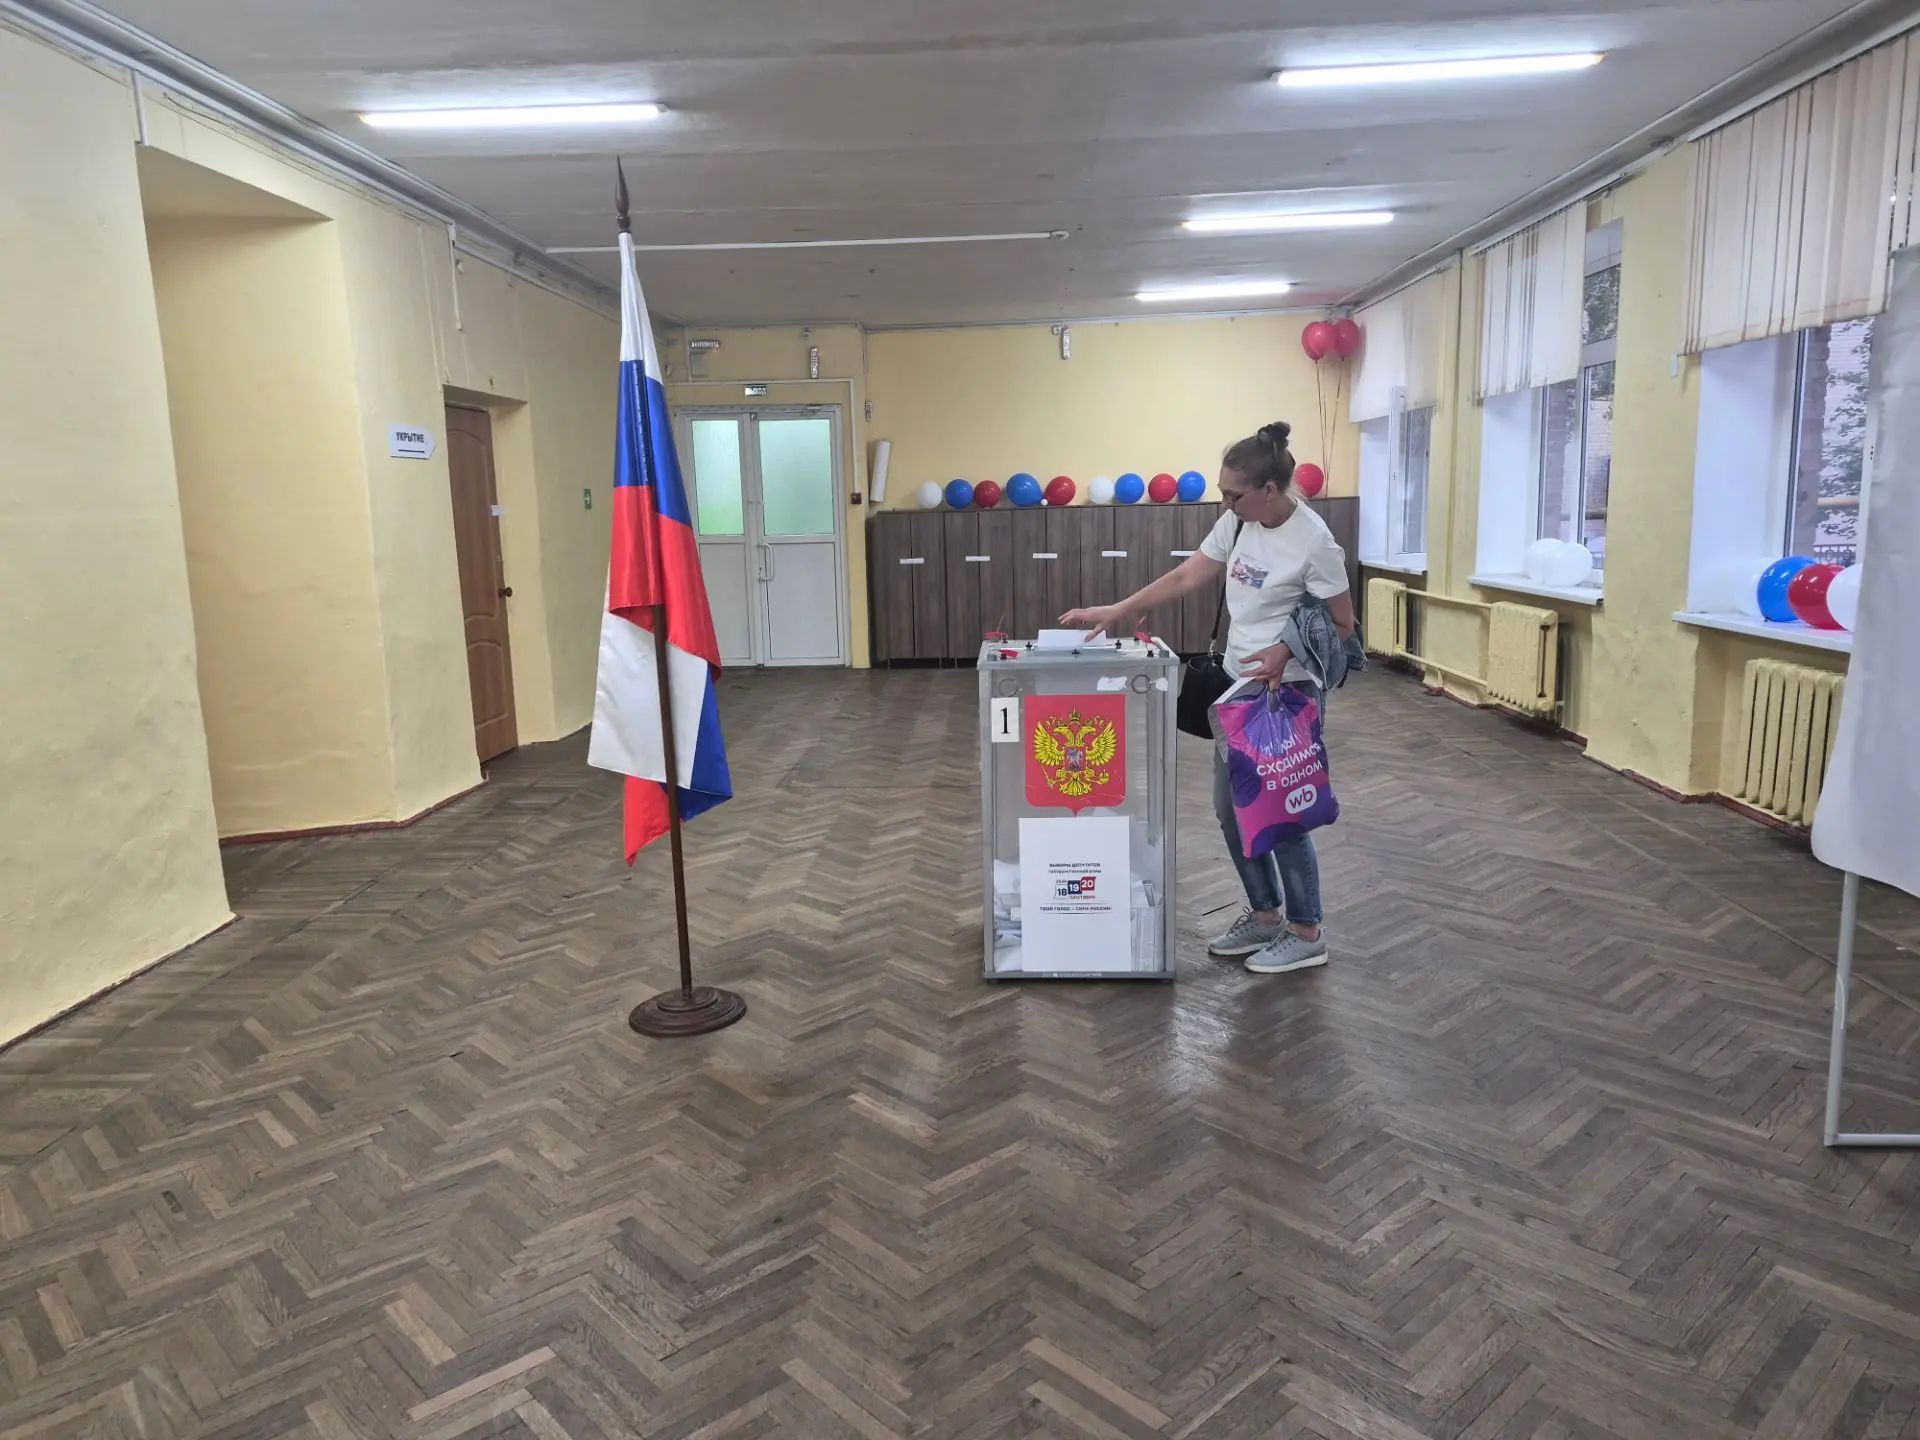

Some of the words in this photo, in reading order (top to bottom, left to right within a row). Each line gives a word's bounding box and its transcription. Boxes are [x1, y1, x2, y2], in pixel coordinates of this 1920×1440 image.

[395, 431, 424, 443] УКРЫТИЕ
[1000, 707, 1011, 734] 1
[1289, 788, 1313, 809] wb
[1057, 888, 1067, 896] 18
[1069, 883, 1080, 892] 19
[1081, 880, 1094, 888] 20
